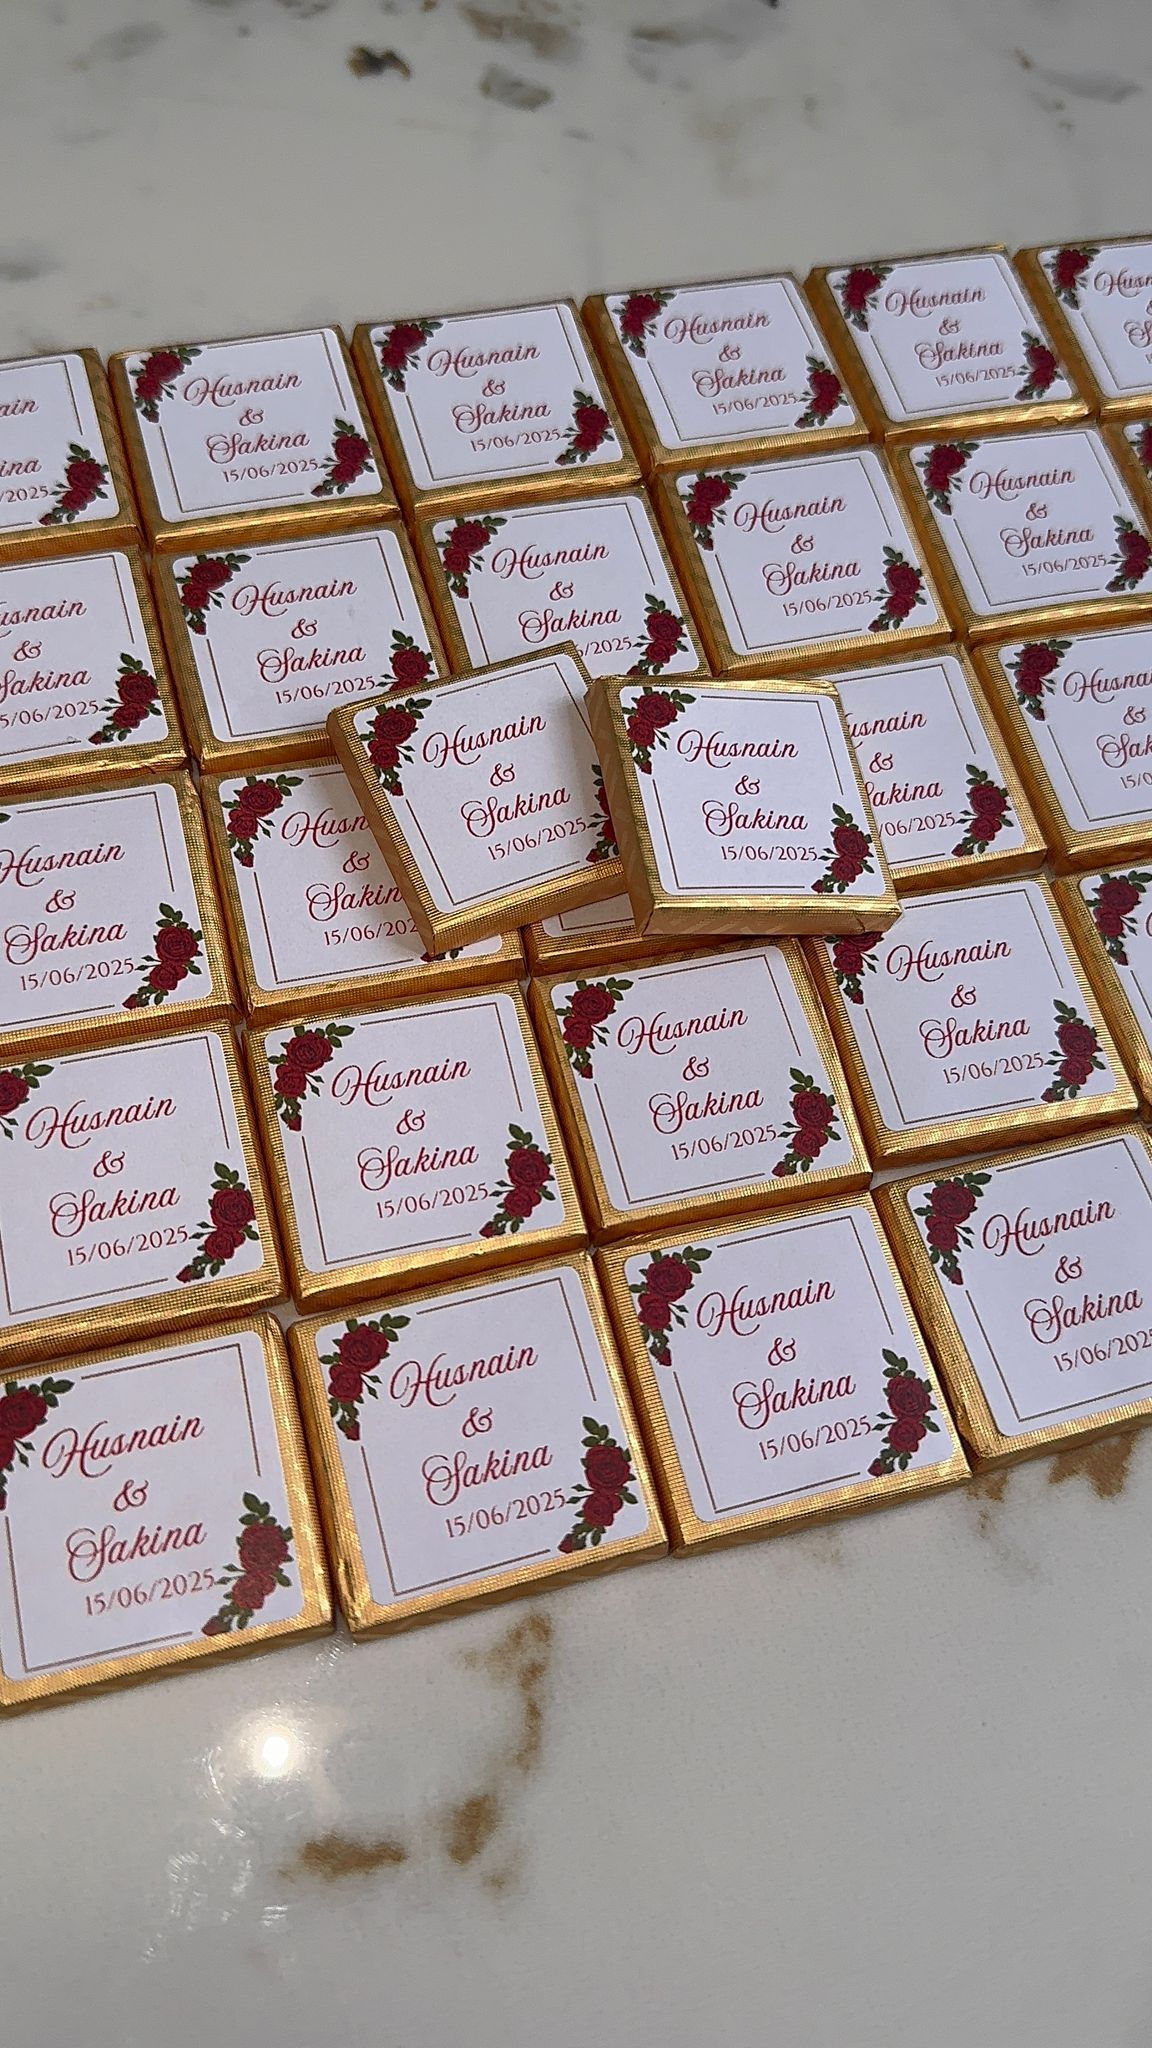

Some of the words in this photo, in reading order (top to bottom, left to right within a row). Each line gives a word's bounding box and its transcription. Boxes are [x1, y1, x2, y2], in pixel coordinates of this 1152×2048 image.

[884, 287, 986, 319] Husnain
[663, 311, 772, 345] Husnain
[427, 343, 541, 379] Husnain
[718, 342, 742, 363] &
[913, 340, 1004, 371] Sakina
[183, 373, 303, 408] Husnain
[481, 377, 506, 398] &
[691, 367, 787, 398] Sakina
[935, 367, 1016, 388] 15/06/2025
[237, 406, 265, 427] &
[450, 401, 552, 434] Sakina
[712, 392, 797, 416] 15/06/2025
[205, 431, 311, 465] Sakina
[469, 429, 561, 453] 15/06/2025
[221, 458, 318, 483] 15/06/2025
[968, 468, 1076, 502] Husnain
[733, 495, 848, 534] Husnain
[1025, 501, 1049, 522] &
[790, 532, 815, 555] &
[999, 526, 1095, 559] Sakina
[491, 543, 610, 580] Husnain
[761, 560, 862, 597] Sakina
[1021, 554, 1107, 577] 15/06/2025
[232, 578, 358, 618] Husnain
[548, 580, 574, 602] &
[782, 591, 872, 617] 15/06/2025
[0, 599, 88, 639] usnain
[290, 617, 318, 640] &
[517, 607, 623, 644] Sakina
[11, 639, 43, 662] &
[576, 636, 632, 658] /2025
[256, 646, 367, 684] Sakina
[275, 677, 376, 705] 15/06/2025
[1062, 667, 1152, 704] Husna
[0, 700, 100, 730] 5/06/2025
[845, 711, 927, 749] usnain
[1123, 705, 1146, 726] &
[422, 715, 547, 769] Husnain
[677, 728, 800, 769] Husnain
[489, 762, 516, 788] &
[868, 751, 894, 774] &
[734, 774, 761, 796] &
[865, 781, 944, 807] akina
[281, 807, 370, 849] Husn
[460, 787, 572, 839] Sakina
[701, 799, 809, 838] Sakina
[879, 812, 956, 839] /06/2025
[487, 816, 588, 861] 15/06/2025
[720, 845, 818, 862] 15/06/2025
[0, 842, 125, 887] Husnain
[342, 850, 371, 874] &
[44, 888, 77, 914] &
[305, 881, 403, 922] Sakin
[2, 922, 129, 966] Sakina
[323, 917, 418, 946] 15/06/202
[20, 958, 135, 992] 15/06/2025
[886, 939, 1012, 983] Husnain
[950, 983, 977, 1009] &
[617, 1007, 749, 1056] Husnain
[918, 1016, 1031, 1060] Sakina
[331, 1056, 472, 1108] Husnain
[682, 1055, 710, 1082] &
[942, 1052, 1045, 1085] 15/06/2025
[25, 1095, 177, 1150] Husnain
[395, 1108, 426, 1136] &
[648, 1089, 765, 1135] Sakina
[670, 1125, 777, 1161] 15/06/2025
[92, 1149, 126, 1179] &
[356, 1144, 480, 1192] Sakina
[48, 1186, 181, 1239] Sakina
[376, 1184, 489, 1219] 15/06/2025
[982, 1199, 1117, 1258] Husnain
[67, 1226, 189, 1267] 15/06/2025
[1054, 1254, 1083, 1285] &
[696, 1278, 836, 1338] Husnain
[1023, 1289, 1144, 1345] Sakina
[767, 1336, 797, 1367] &
[390, 1345, 539, 1409] Husnain
[731, 1374, 857, 1431] Sakina
[461, 1406, 494, 1439] &
[758, 1415, 871, 1461] 15/06/2025
[42, 1414, 206, 1479] Husnain
[421, 1444, 554, 1507] Sakina
[112, 1478, 150, 1513] &
[445, 1489, 566, 1539] 15/06/2025
[64, 1522, 208, 1584] Sakina
[85, 1568, 215, 1617] 15/06/2025
